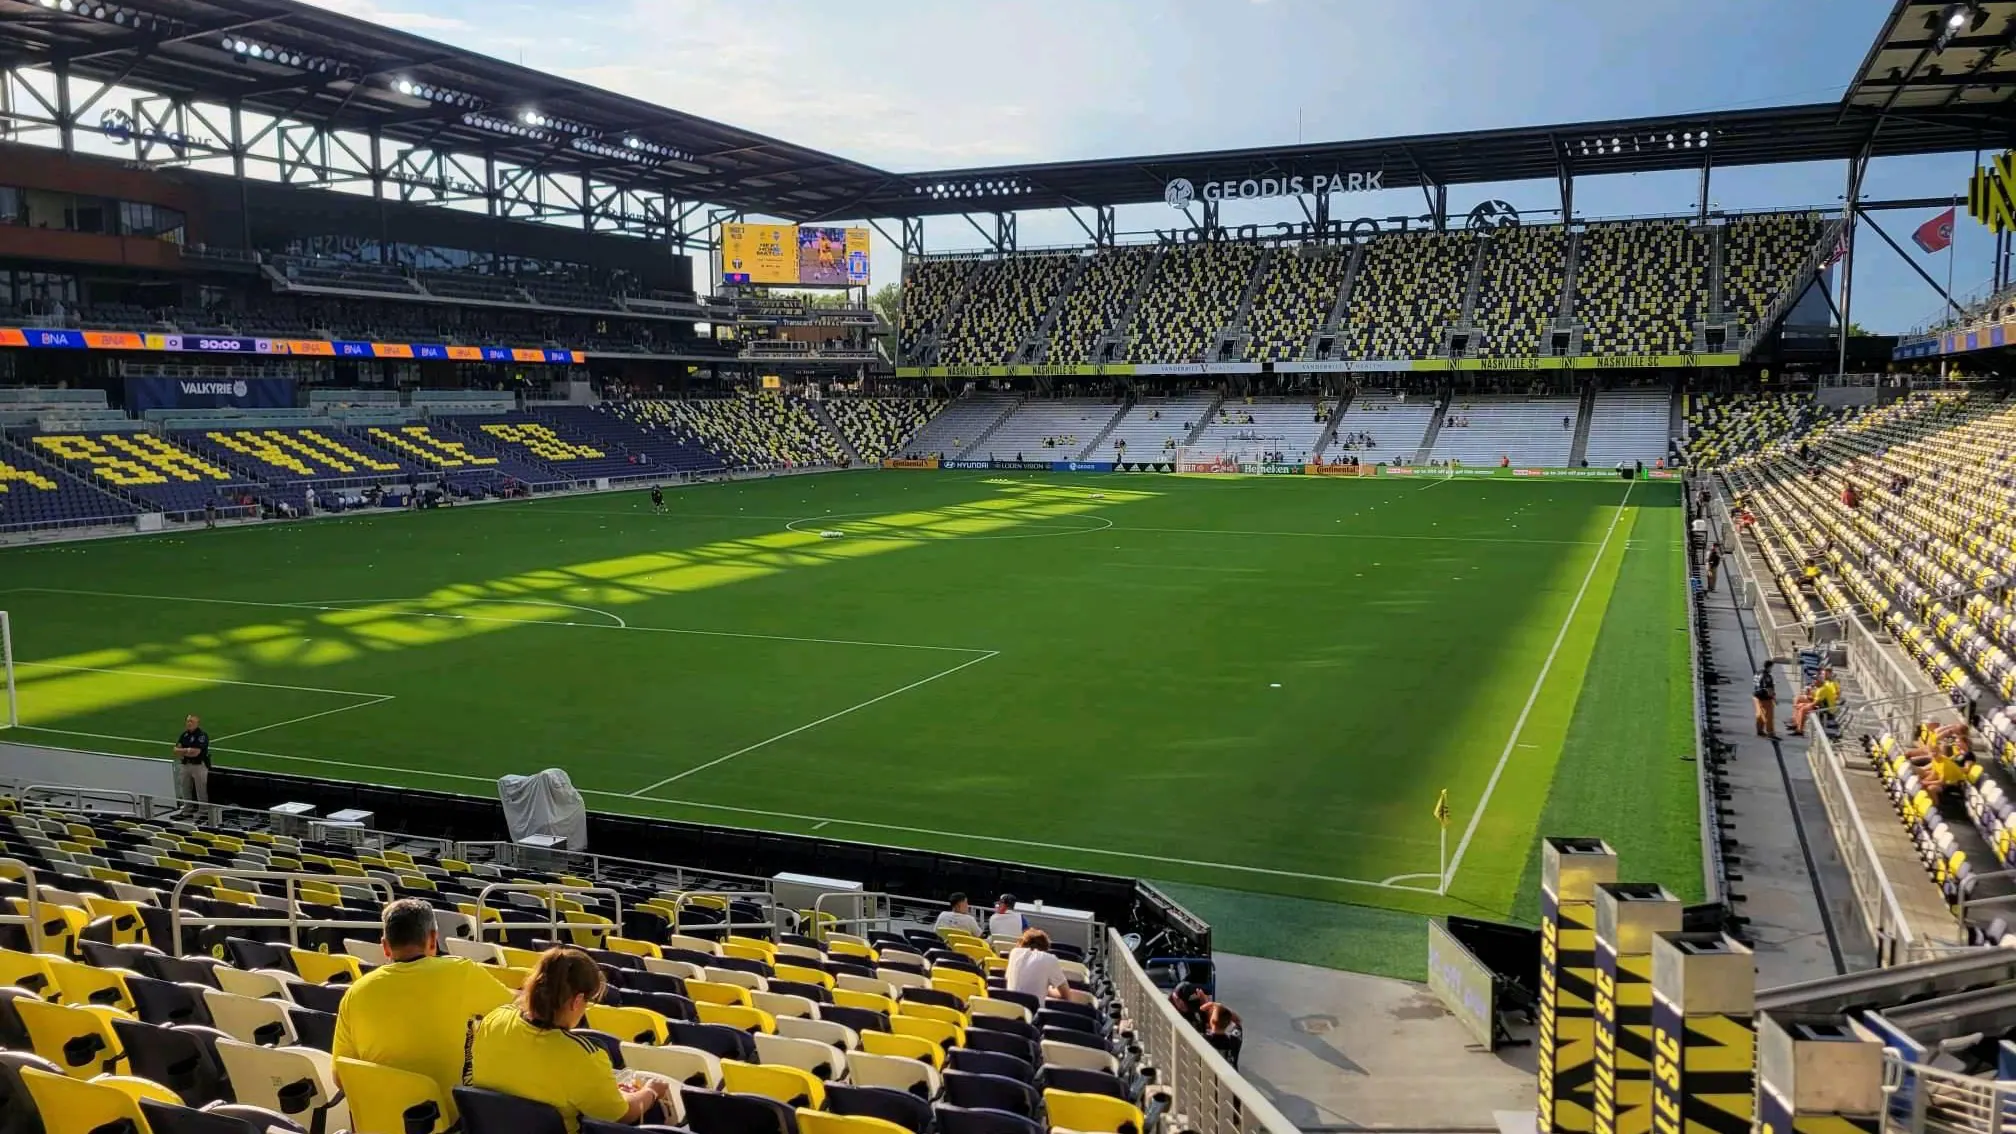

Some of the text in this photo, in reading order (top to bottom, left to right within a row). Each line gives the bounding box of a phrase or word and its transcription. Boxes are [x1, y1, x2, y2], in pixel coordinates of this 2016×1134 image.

[1202, 170, 1384, 202] GEODIS PARK
[41, 333, 69, 345] BNA
[199, 339, 241, 350] 30:00
[343, 345, 362, 354] BNA
[421, 347, 438, 357] BNA
[490, 350, 504, 359] BNA
[550, 352, 564, 361] BNA
[1345, 362, 1353, 371] V
[1480, 358, 1540, 369] NASHVILLE SC
[1597, 356, 1660, 367] NASHVILLE SC
[947, 366, 990, 376] NASHVILLE SC
[1032, 364, 1077, 375] NASHVILLE SC
[1200, 364, 1209, 372] V
[180, 381, 232, 395] VALKYRIE
[892, 459, 924, 468] Continental
[1244, 464, 1290, 474] Heineken
[1316, 465, 1356, 475] Continental
[1542, 915, 1556, 964] SC
[1596, 968, 1615, 1022] SC
[1655, 1027, 1680, 1092] SC
